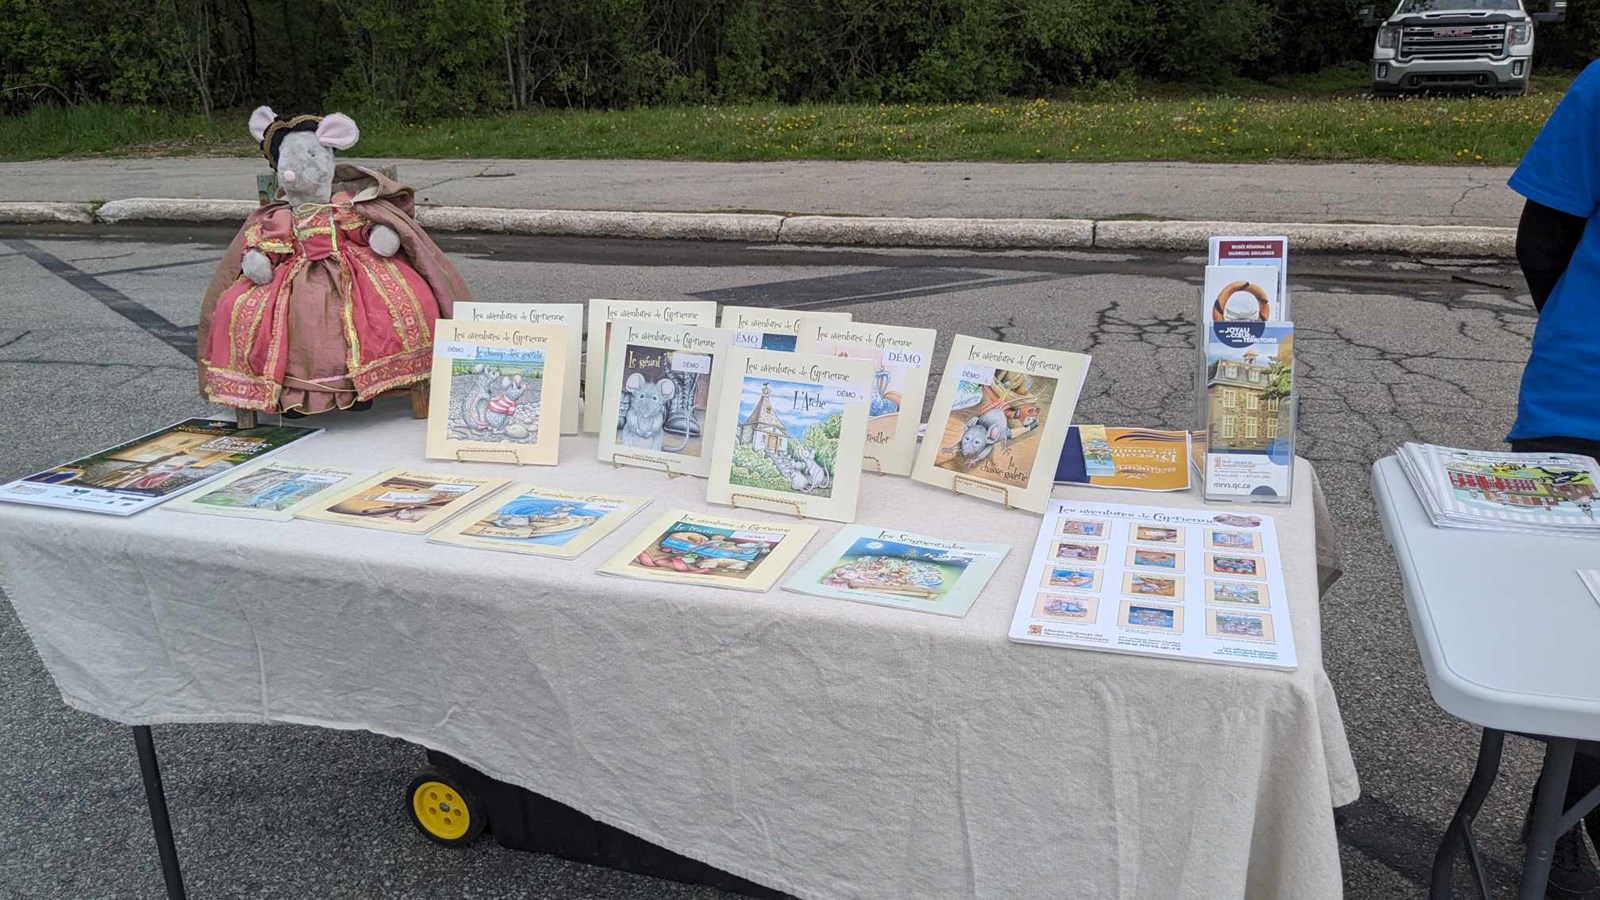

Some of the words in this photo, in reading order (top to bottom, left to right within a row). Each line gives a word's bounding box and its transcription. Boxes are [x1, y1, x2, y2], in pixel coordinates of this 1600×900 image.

[1433, 28, 1472, 39] GMC
[473, 308, 483, 322] Les
[486, 310, 518, 320] aventures
[520, 311, 528, 320] de
[607, 306, 618, 319] Les
[621, 308, 651, 318] aventures
[654, 309, 661, 318] de
[664, 307, 699, 322] Cyprienne
[738, 314, 749, 328] Les
[751, 318, 782, 328] aventures
[454, 327, 465, 341] Les
[468, 330, 500, 341] aventures
[503, 333, 510, 341] de
[628, 327, 638, 342] Les
[641, 331, 671, 342] aventures
[674, 334, 681, 343] de
[683, 332, 716, 348] Cyprienne
[736, 332, 759, 344] ÉMO
[817, 327, 828, 341] Les
[830, 330, 863, 343] aventures
[866, 333, 874, 343] de
[876, 332, 912, 349] Cyprienne
[628, 351, 637, 368] Le
[639, 353, 661, 368] géant
[888, 351, 921, 365] DÉMO
[968, 345, 980, 361] Les
[982, 351, 1016, 365] aventures
[1017, 356, 1025, 366] de
[1026, 354, 1063, 372] Cyprienne
[745, 357, 758, 374] Les
[760, 361, 796, 376] aventures
[799, 365, 808, 377] de
[809, 364, 850, 383] Cyprienne
[793, 390, 827, 411] L'Arche
[836, 388, 856, 399] DÉMO
[1213, 482, 1251, 490] mrvs.qc.ca
[1058, 505, 1076, 514] Les
[1079, 509, 1134, 517] aventures
[878, 531, 894, 539] Les
